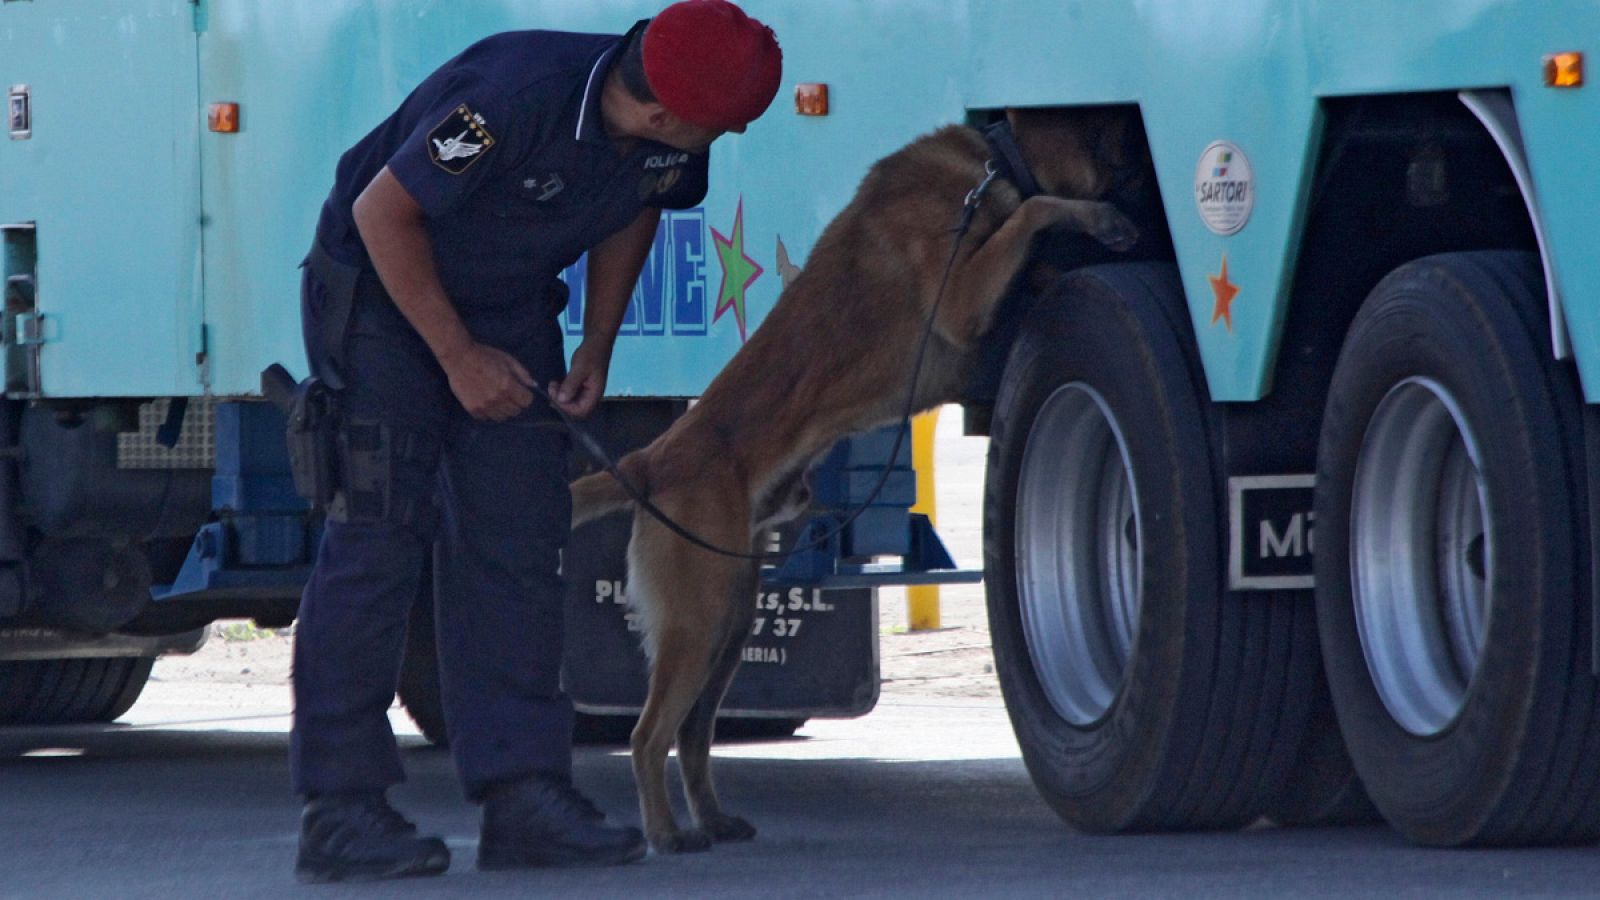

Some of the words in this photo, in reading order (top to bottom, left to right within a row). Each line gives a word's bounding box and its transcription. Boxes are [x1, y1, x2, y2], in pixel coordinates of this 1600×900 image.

[1200, 181, 1248, 203] SARTORI
[595, 580, 628, 604] PL
[773, 618, 802, 637] 37
